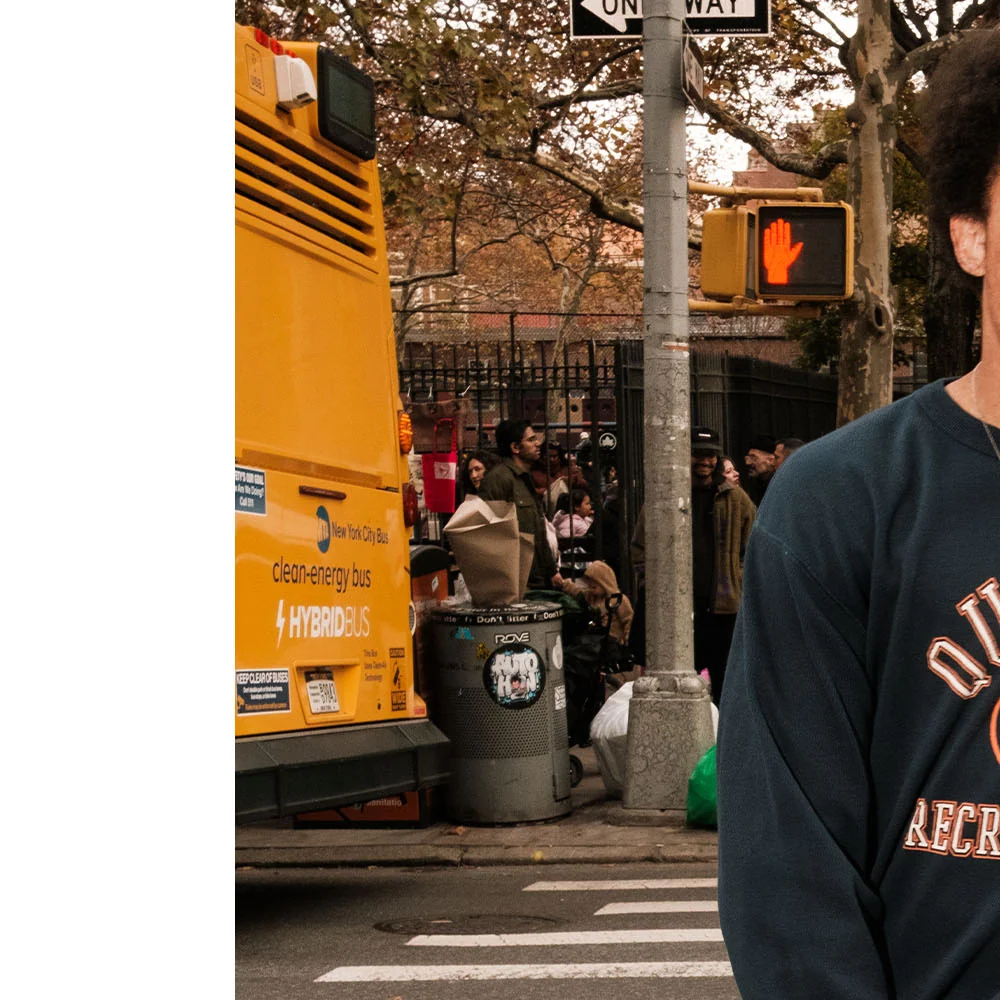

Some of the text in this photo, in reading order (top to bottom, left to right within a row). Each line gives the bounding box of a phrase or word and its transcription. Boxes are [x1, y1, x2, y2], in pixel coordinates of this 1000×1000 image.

[602, 0, 637, 15] ON
[331, 521, 346, 539] New
[347, 523, 362, 540] York
[363, 525, 375, 546] City
[376, 527, 388, 544] Bus
[272, 556, 371, 593] clean-energy bus
[477, 614, 502, 624] Don't
[495, 632, 530, 643] ROVE
[491, 651, 539, 675] AUTO
[237, 671, 288, 685] KEEP CLEAR OF BUSES
